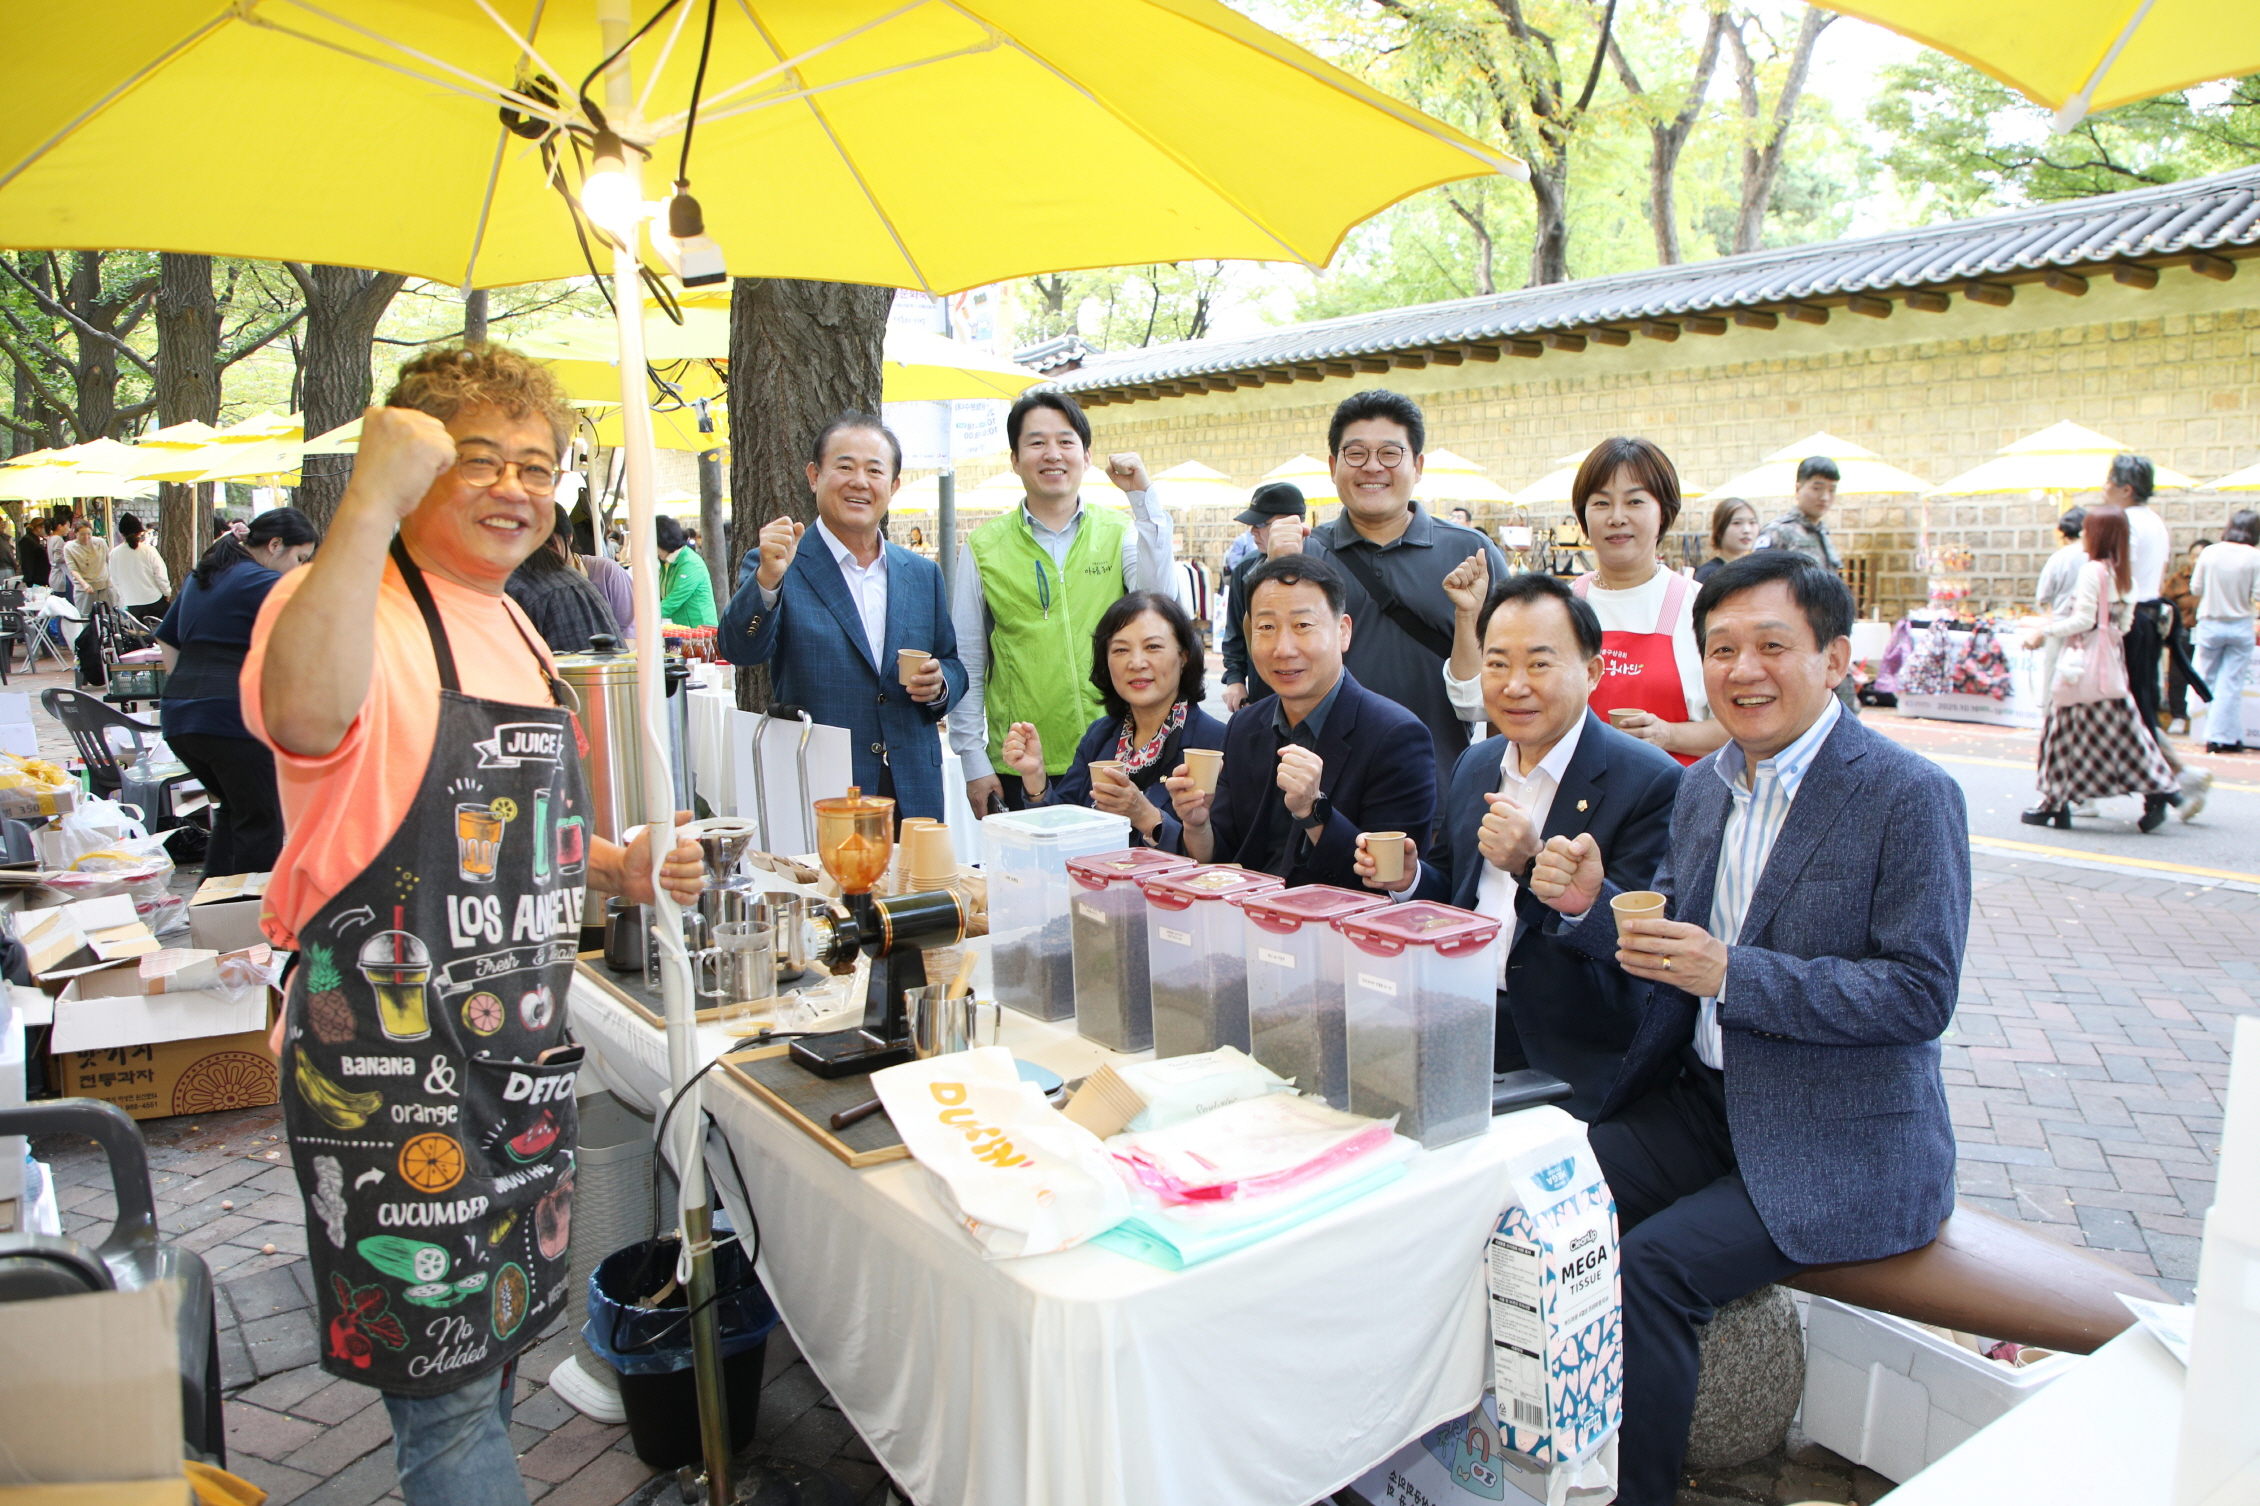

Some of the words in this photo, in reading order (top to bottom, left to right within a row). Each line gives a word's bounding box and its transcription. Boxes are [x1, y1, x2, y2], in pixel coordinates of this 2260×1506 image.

[1600, 648, 1628, 660] 중구상공회
[506, 731, 557, 754] JUICE
[447, 894, 502, 949] LOS
[475, 956, 520, 978] Fresh
[80, 1068, 154, 1089] 전통과자
[423, 1054, 460, 1097] &
[502, 1071, 579, 1105] DETO
[1569, 1229, 1598, 1252] CleanUp
[1562, 1245, 1608, 1285] MEGA
[1570, 1270, 1602, 1295] TISSUE
[425, 1315, 474, 1347] No
[408, 1334, 489, 1378] Added
